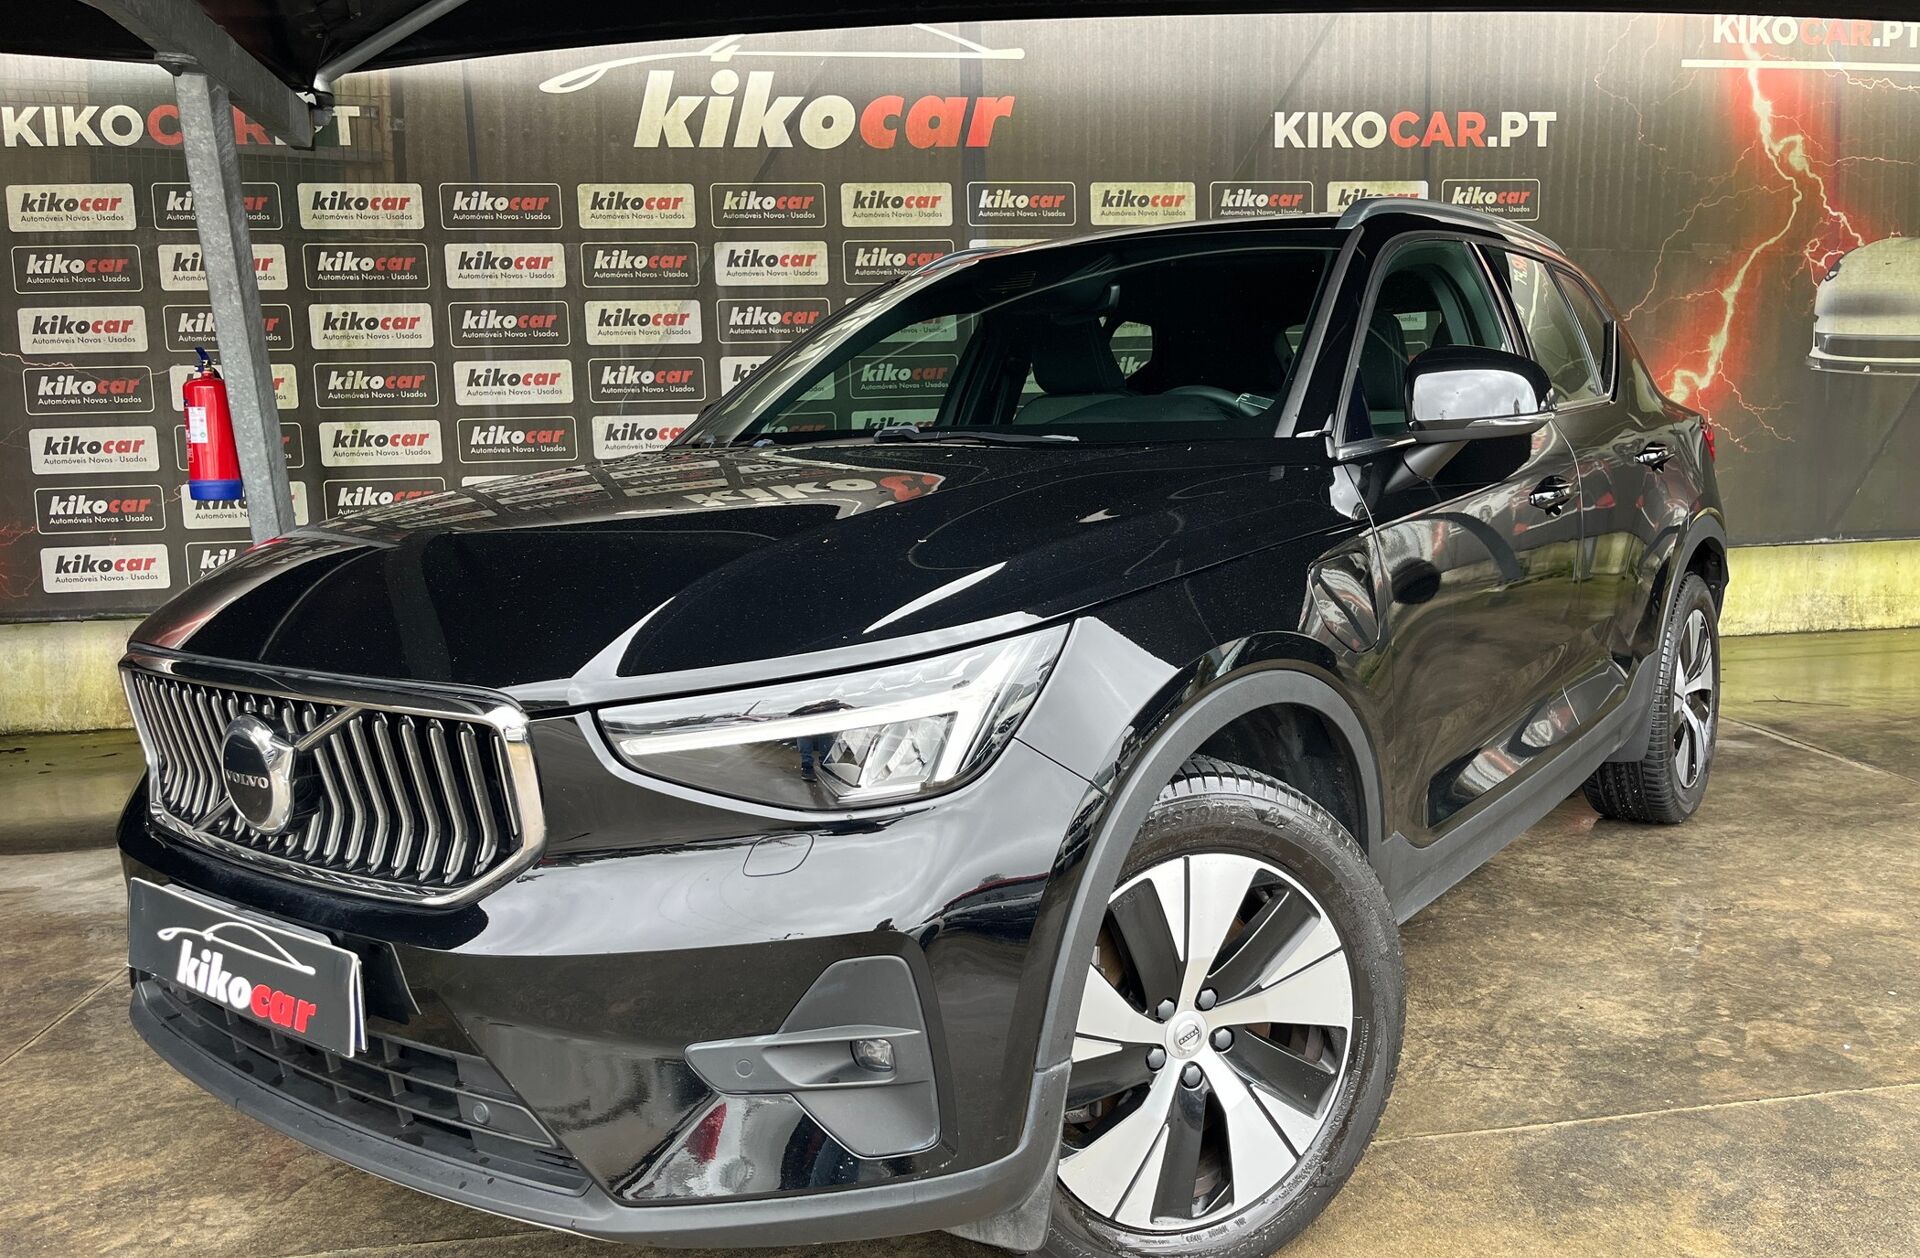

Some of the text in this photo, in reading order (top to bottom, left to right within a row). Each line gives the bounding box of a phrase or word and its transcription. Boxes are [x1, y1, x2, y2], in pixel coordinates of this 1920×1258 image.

[1713, 15, 1920, 48] KIKOCAR.PT
[633, 69, 1014, 149] kikocar
[1274, 111, 1557, 149] KIKOCAR.PT
[21, 193, 122, 212] kikocar
[312, 191, 410, 211] kikocar
[453, 191, 548, 210] kikocar
[591, 192, 683, 210] kikocar
[723, 191, 813, 210] kikocar
[853, 191, 941, 208] kikocar
[979, 190, 1065, 208] kikocar
[1102, 190, 1185, 207] kikocar
[1221, 190, 1303, 207] kikocar
[1452, 187, 1530, 204] kikocar
[355, 212, 381, 220] Novos
[386, 212, 414, 220] Usados
[632, 212, 655, 220] Novos
[659, 212, 686, 220] Usados
[1163, 208, 1185, 216] Usados
[27, 254, 127, 274] kikocar
[318, 252, 415, 271] kikocar
[458, 251, 553, 269] kikocar
[594, 250, 686, 268] kikocar
[727, 249, 816, 267] kikocar
[102, 274, 130, 282] Usados
[391, 272, 417, 280] Usados
[32, 315, 133, 334] kikocar
[323, 312, 420, 330] kikocar
[462, 310, 556, 329] kikocar
[598, 309, 689, 326] kikocar
[729, 307, 820, 325] kikocar
[396, 332, 422, 340] Usados
[666, 328, 691, 336] Usados
[328, 371, 425, 392] kikocar
[467, 369, 560, 386] kikocar
[602, 366, 692, 384] kikocar
[861, 364, 948, 381] kikocar
[38, 376, 139, 397] kikocar
[670, 384, 694, 392] Usados
[114, 396, 141, 404] Usados
[333, 429, 429, 448] kikocar
[471, 426, 564, 444] kikocar
[44, 436, 144, 455] kikocar
[49, 495, 150, 516] kikocar
[125, 514, 153, 522] Usados
[55, 555, 155, 576] kikocar
[225, 769, 269, 789] VOLVO
[176, 940, 316, 1034] kikocar
